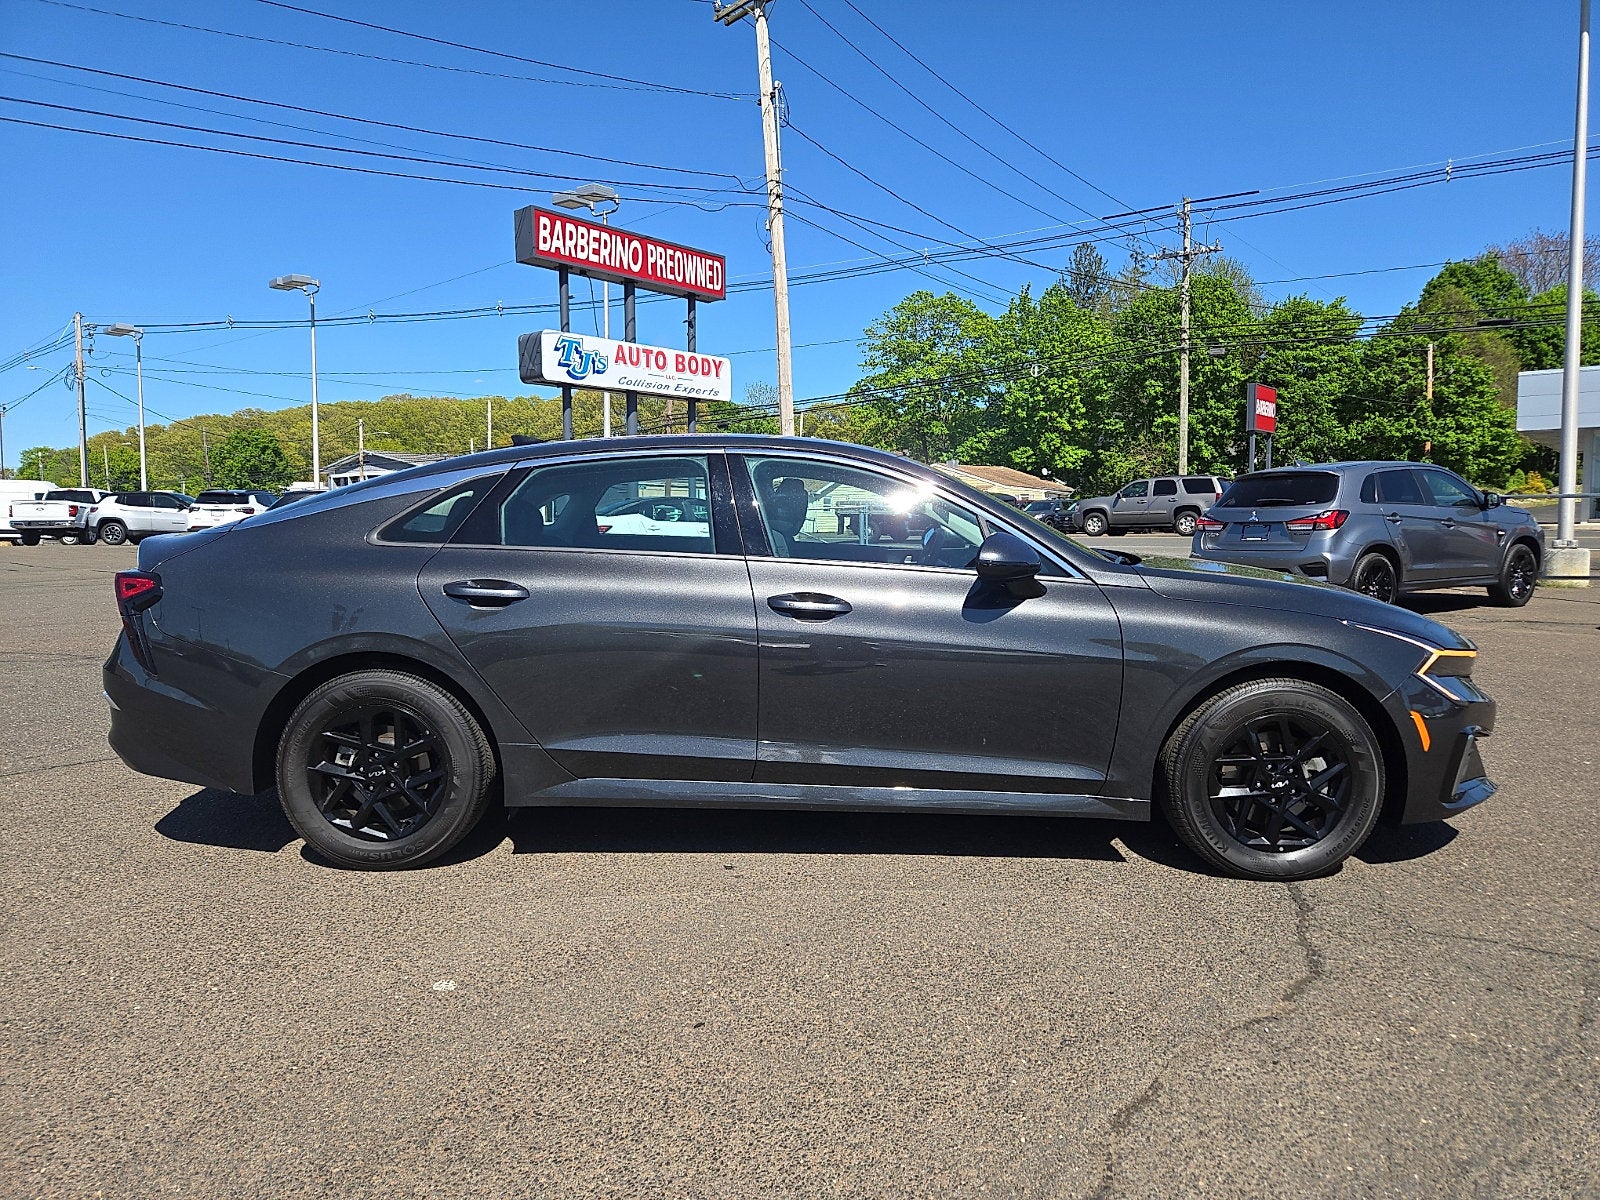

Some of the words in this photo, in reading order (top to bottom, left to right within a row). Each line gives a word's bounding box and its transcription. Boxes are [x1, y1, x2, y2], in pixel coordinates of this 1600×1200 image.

[538, 215, 643, 273] BARBERINO
[646, 243, 722, 291] PREOWNED
[554, 335, 609, 381] TJ's
[614, 344, 668, 372] AUTO
[675, 353, 724, 378] BODY
[618, 376, 670, 391] Collision
[674, 383, 720, 398] Experts
